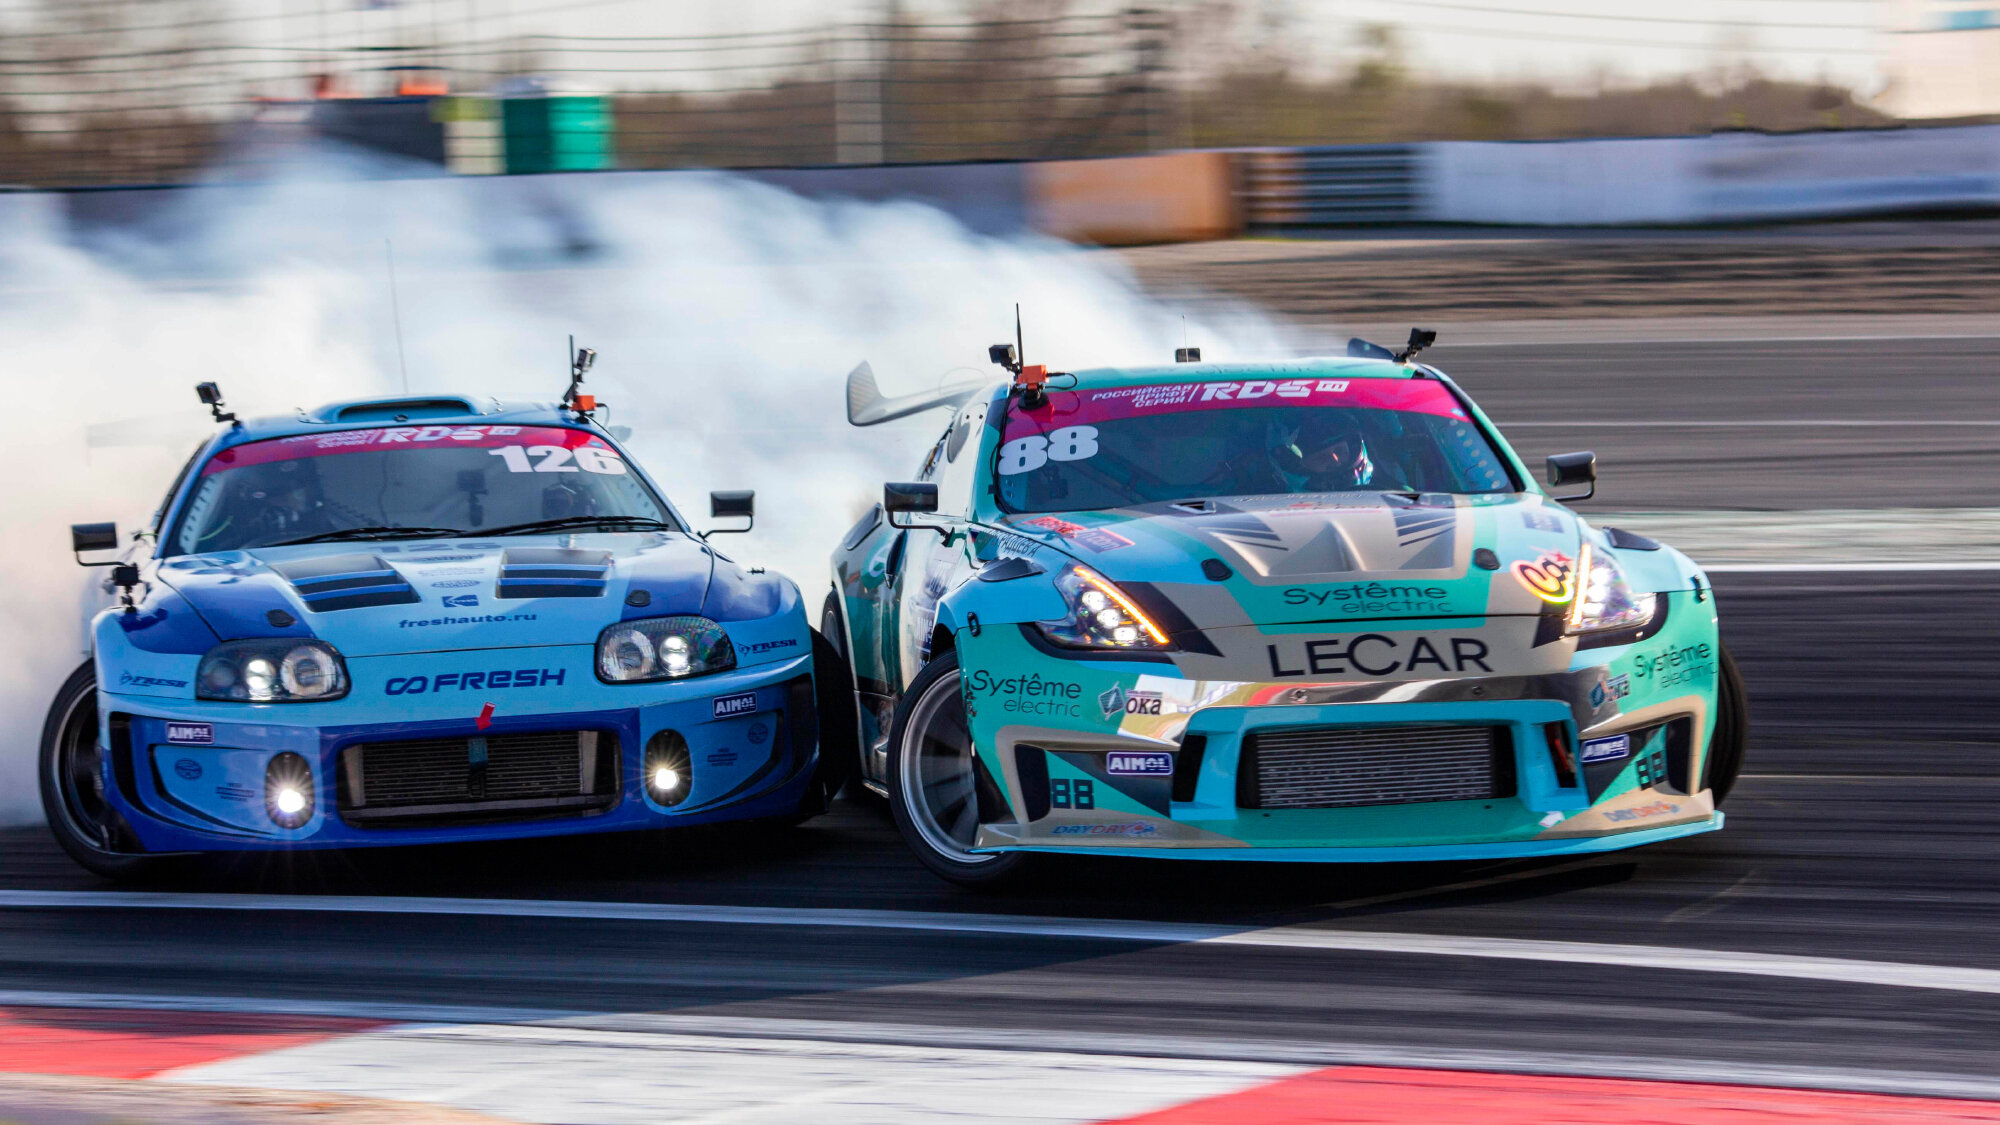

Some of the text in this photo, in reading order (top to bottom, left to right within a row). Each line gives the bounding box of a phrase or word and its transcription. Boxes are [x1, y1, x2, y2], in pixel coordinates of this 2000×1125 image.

[1091, 384, 1193, 401] РОССИЙСКАЯ
[1132, 390, 1187, 403] ДРИФТ
[1200, 380, 1315, 401] RDS
[1135, 396, 1185, 408] СЕРИЯ
[379, 426, 491, 443] RDS
[998, 425, 1099, 475] 88
[489, 445, 627, 475] 126
[368, 542, 502, 552] 126
[1283, 582, 1448, 605] Système
[1341, 600, 1454, 613] electric
[399, 613, 537, 628] freshauto.ru
[752, 639, 797, 652] FRESH
[1267, 634, 1494, 677] LECAR
[132, 676, 189, 688] FRESH
[433, 668, 566, 692] FRESH
[971, 670, 1082, 698] Système
[716, 697, 755, 714] AIMOL
[1003, 697, 1081, 718] electric
[168, 727, 211, 740] AIMOL
[1110, 757, 1169, 771] AIMOL
[1635, 751, 1667, 791] 88
[1051, 778, 1094, 809] 88
